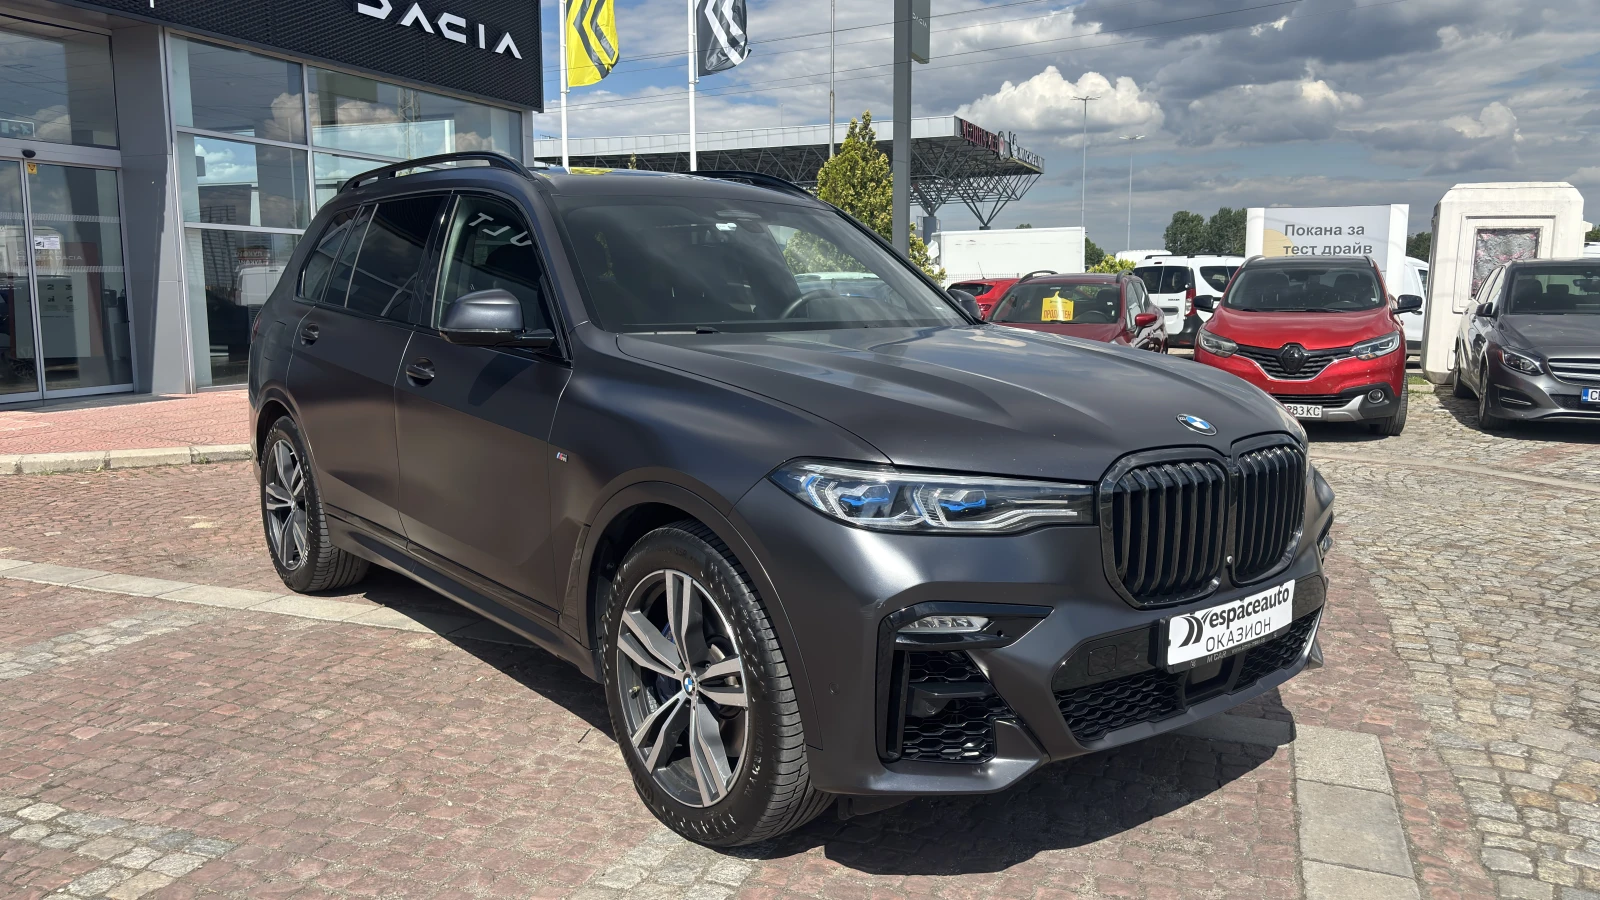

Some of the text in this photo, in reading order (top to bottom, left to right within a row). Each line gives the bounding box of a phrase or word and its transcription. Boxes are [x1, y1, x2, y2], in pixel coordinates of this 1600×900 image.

[1284, 224, 1365, 237] Покана за
[1283, 242, 1373, 255] тест драйв
[1209, 587, 1290, 629] espaceauto
[1205, 617, 1271, 653] ОКАЗИОН
